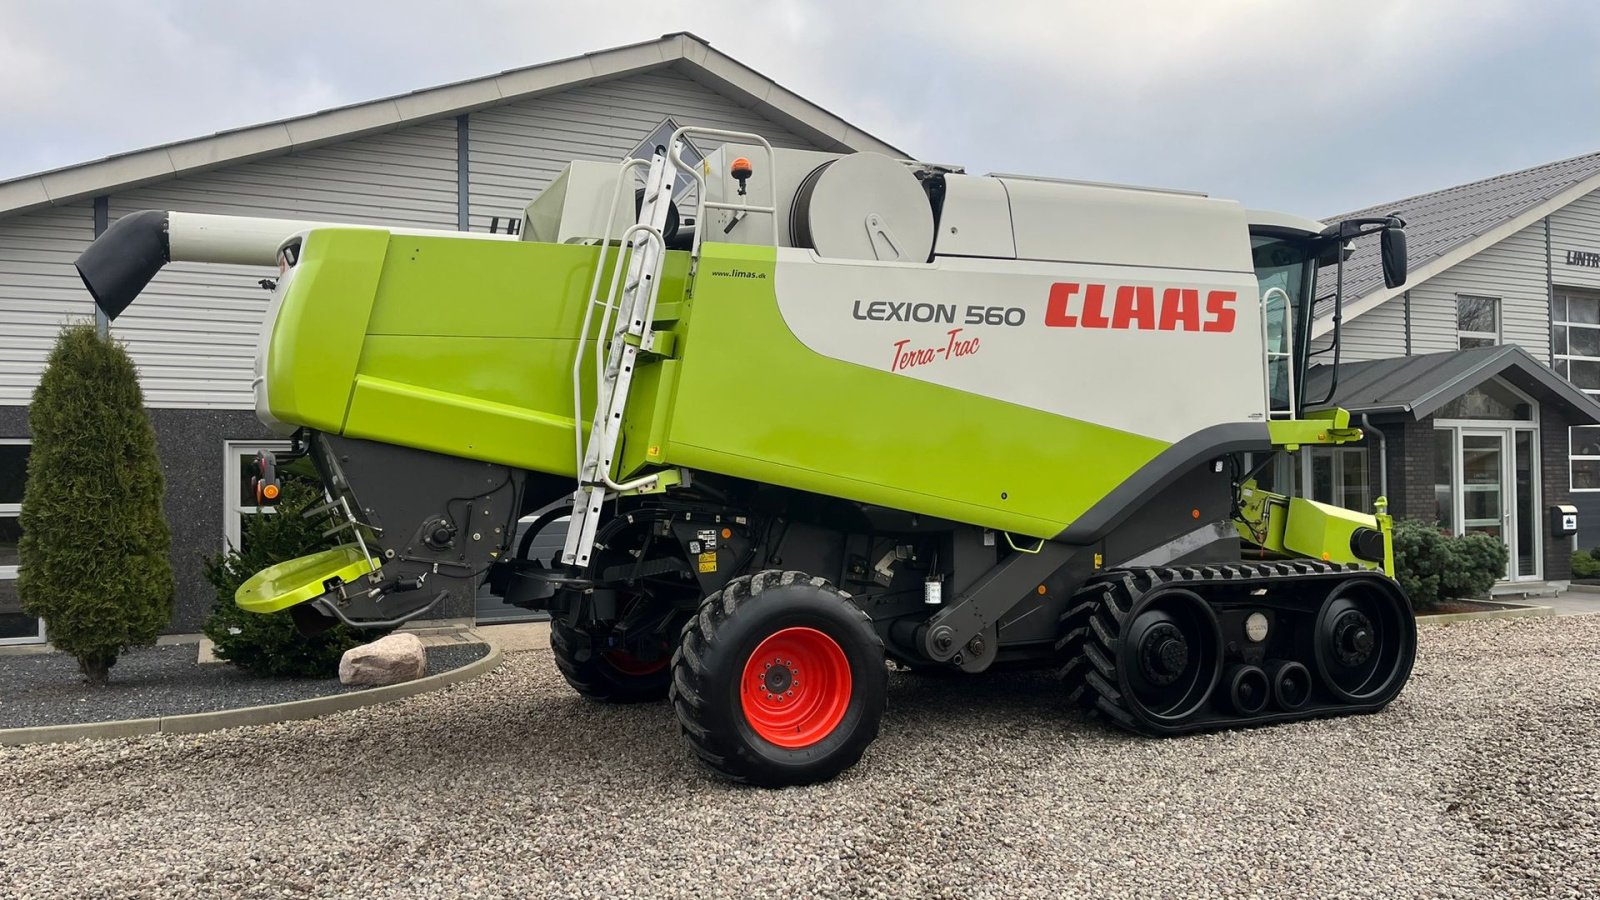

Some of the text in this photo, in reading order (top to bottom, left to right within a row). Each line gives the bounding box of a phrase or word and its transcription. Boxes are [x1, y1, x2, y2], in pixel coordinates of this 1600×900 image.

[712, 269, 767, 279] www.limas.dk
[852, 300, 1026, 327] LEXION 560
[1045, 282, 1237, 333] CLAAS
[891, 328, 980, 372] Terra-Trac
